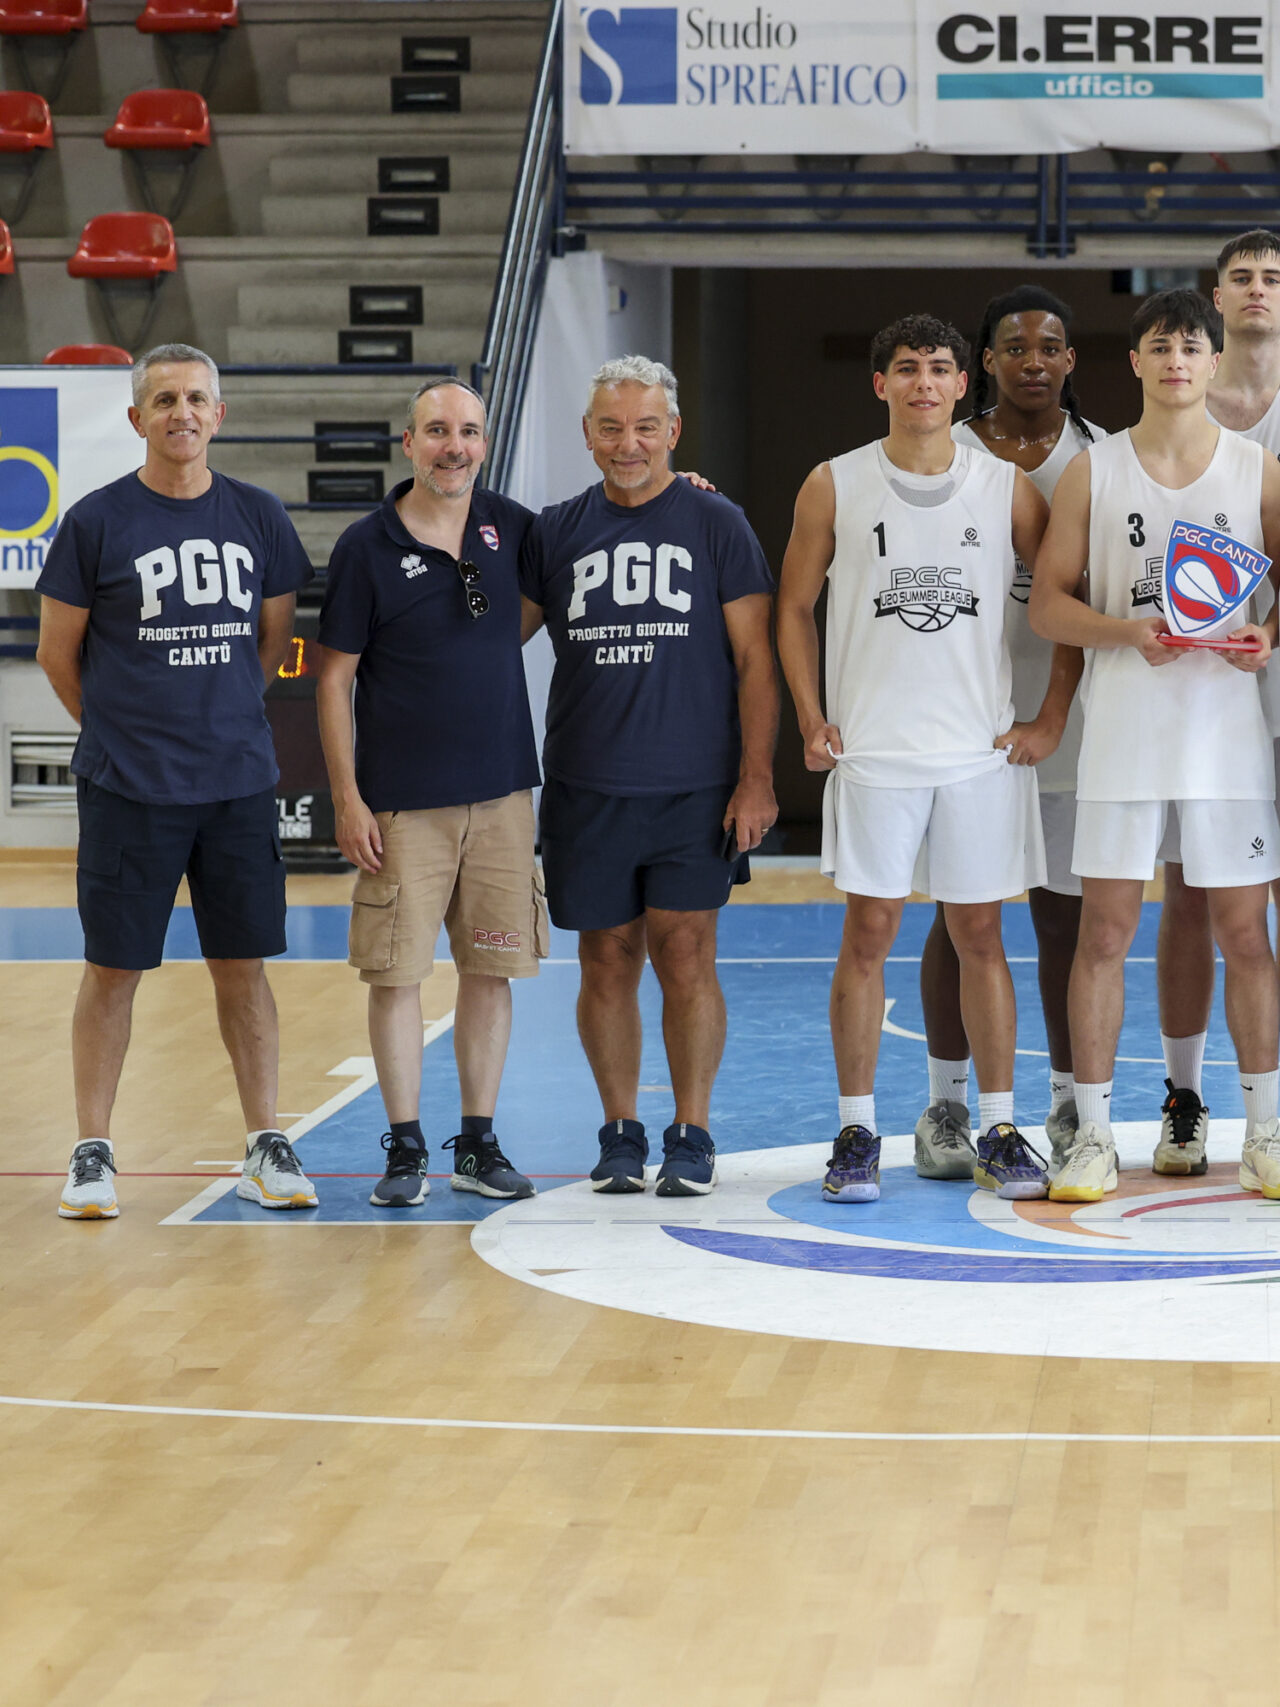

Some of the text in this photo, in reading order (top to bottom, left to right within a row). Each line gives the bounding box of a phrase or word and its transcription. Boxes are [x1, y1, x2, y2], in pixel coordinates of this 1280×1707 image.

[686, 6, 797, 50] Studio
[936, 14, 1264, 64] CI.ERRE
[685, 63, 908, 106] SPREAFICO
[1045, 75, 1154, 97] ufficio
[872, 521, 887, 558] 1
[1127, 512, 1146, 547] 3
[1172, 525, 1266, 576] PGC CANTÙ
[134, 538, 254, 621] PGC
[567, 541, 693, 622] PGC
[890, 566, 962, 590] PGC
[1136, 581, 1153, 596] U20
[881, 589, 972, 607] U20 SUMMER LEAGUE
[138, 625, 207, 641] PROGETTO
[567, 622, 690, 641] PROGETTO GIOVANI
[168, 641, 231, 666] CANTÙ
[595, 640, 655, 665] CANTÙ
[473, 928, 521, 946] PGC
